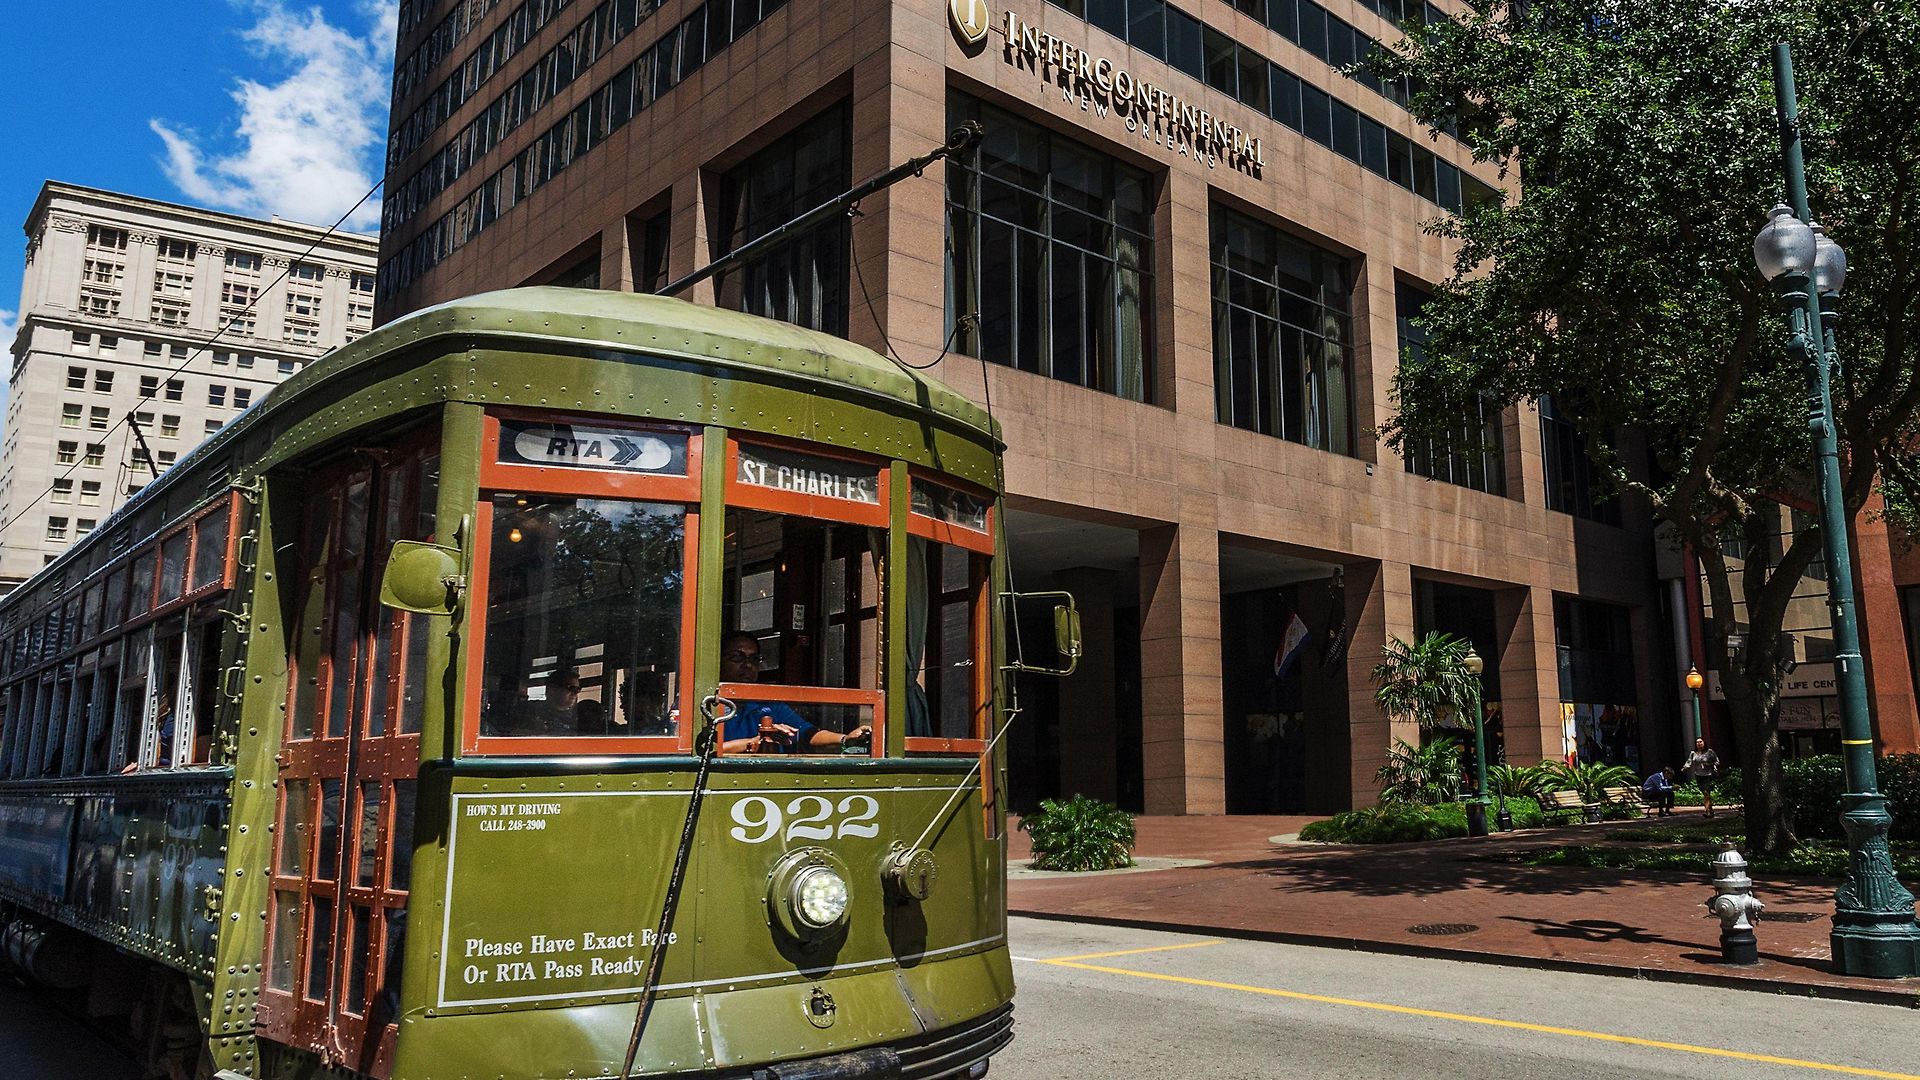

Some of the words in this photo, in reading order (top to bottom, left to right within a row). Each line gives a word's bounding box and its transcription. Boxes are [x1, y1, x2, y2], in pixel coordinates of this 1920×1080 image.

[1005, 9, 1266, 167] INTERCONTINENTAL
[1063, 87, 1109, 119] NEW
[1125, 117, 1215, 169] ORLEANS
[546, 437, 603, 459] RTA
[743, 459, 769, 484] ST
[777, 465, 868, 502] CHARLES
[1787, 681, 1809, 690] LIFE
[466, 803, 498, 817] HOW'S
[499, 803, 516, 816] MY
[518, 802, 561, 815] DRIVING
[730, 795, 880, 844] 922
[479, 819, 506, 832] CALL
[507, 818, 547, 831] 248-3900
[464, 938, 523, 958] Please
[530, 934, 576, 955] Have
[582, 931, 635, 951] Exact
[463, 964, 489, 985] Or
[495, 961, 537, 983] RTA
[544, 959, 584, 980] Pass
[590, 955, 645, 976] Ready
